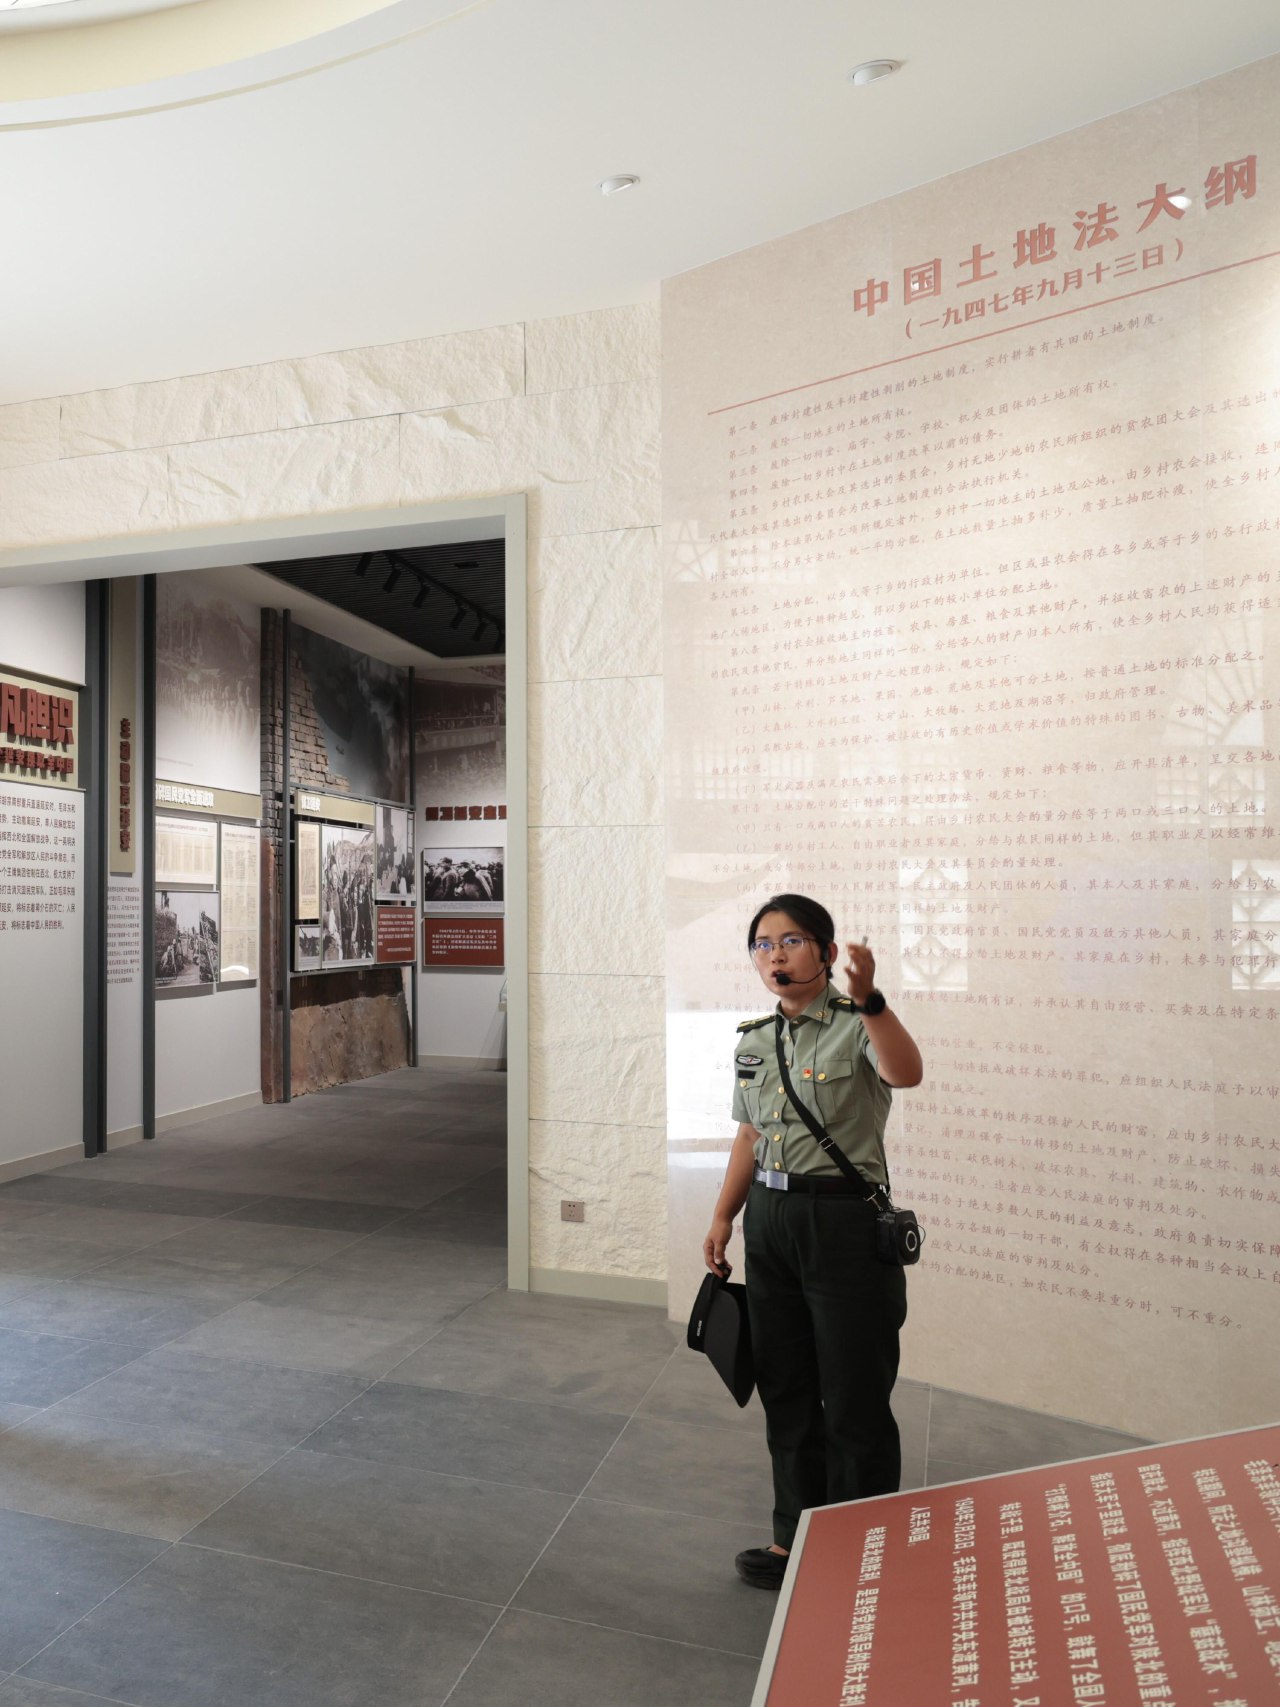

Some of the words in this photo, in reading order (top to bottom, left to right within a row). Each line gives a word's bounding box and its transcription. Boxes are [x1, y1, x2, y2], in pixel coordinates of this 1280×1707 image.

[853, 154, 1258, 317] 中国土地法大纲
[904, 238, 1185, 341] （一九四七年九月十三日）
[728, 419, 758, 438] 第一条
[728, 443, 758, 461] 第二条
[728, 463, 758, 481] 第三条
[729, 483, 758, 501] 第四条
[729, 502, 759, 520] 第五条
[730, 543, 759, 560] 第六条
[730, 603, 759, 619] 第七条
[730, 642, 759, 658] 第八条
[773, 568, 1280, 652] 乡村农会接收地主的牲畜、农具、房屋、粮食及其他财产，并征收富农的上述财产的
[730, 682, 760, 697] 第九条
[732, 801, 760, 814] 第十条
